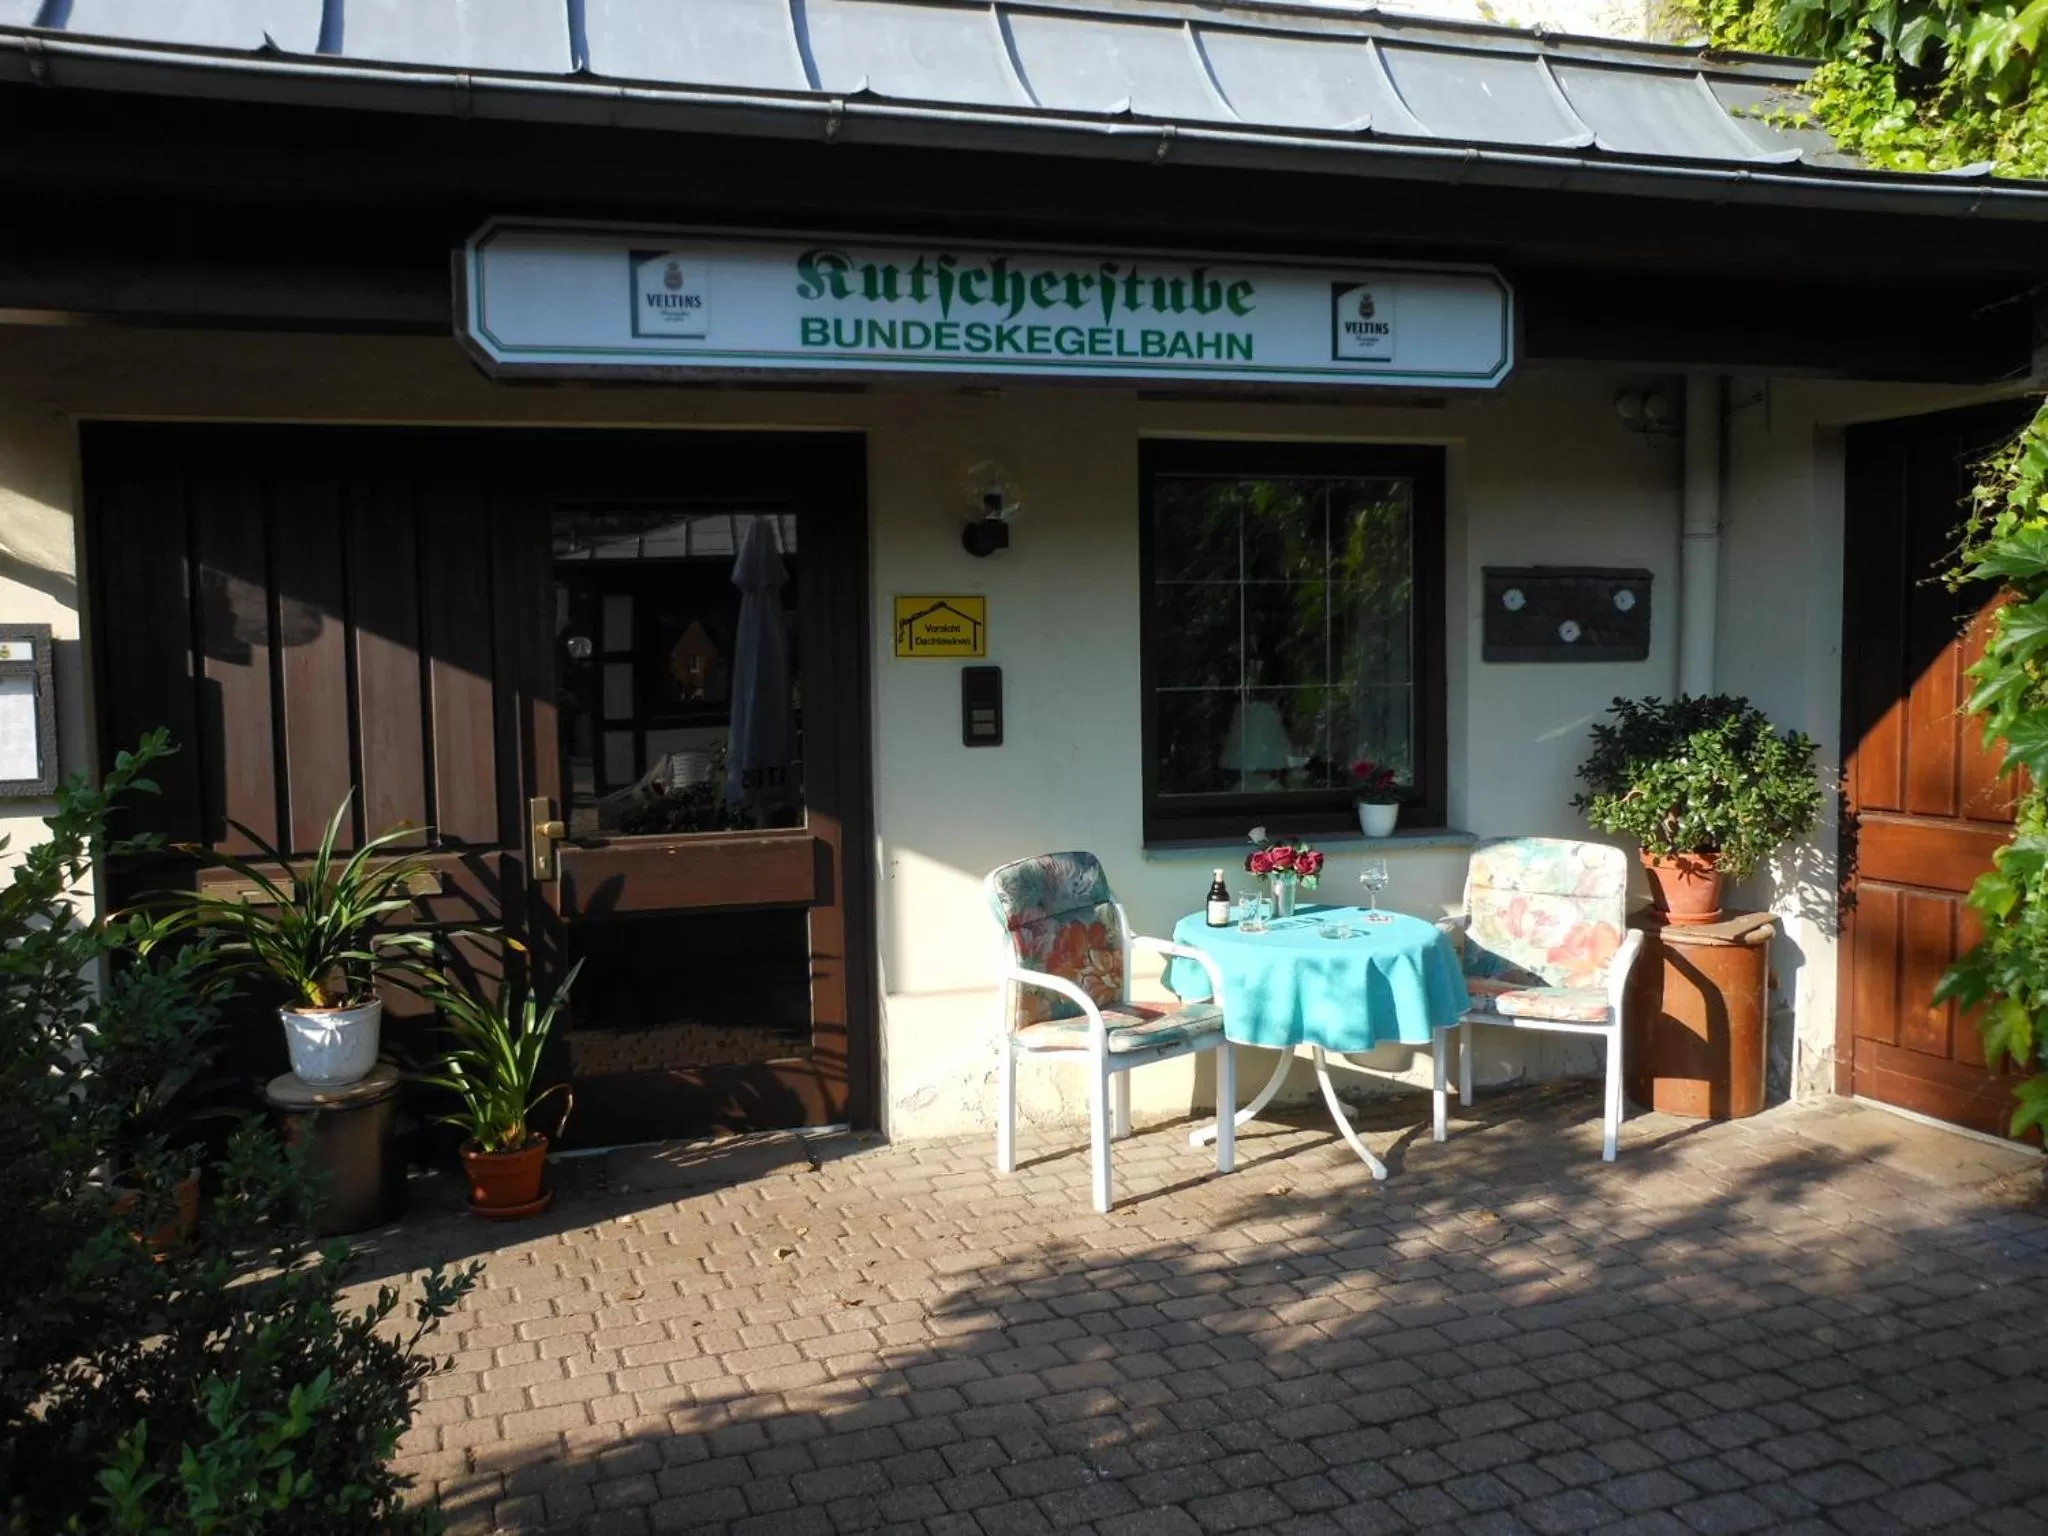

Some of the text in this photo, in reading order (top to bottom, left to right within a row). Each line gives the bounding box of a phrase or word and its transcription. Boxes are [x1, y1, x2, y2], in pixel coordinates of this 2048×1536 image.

[646, 293, 702, 309] VELTINS
[1345, 321, 1390, 335] VELTINS
[801, 317, 1253, 360] BUNDESKEGELBAHN
[924, 623, 961, 633] Vorsicht
